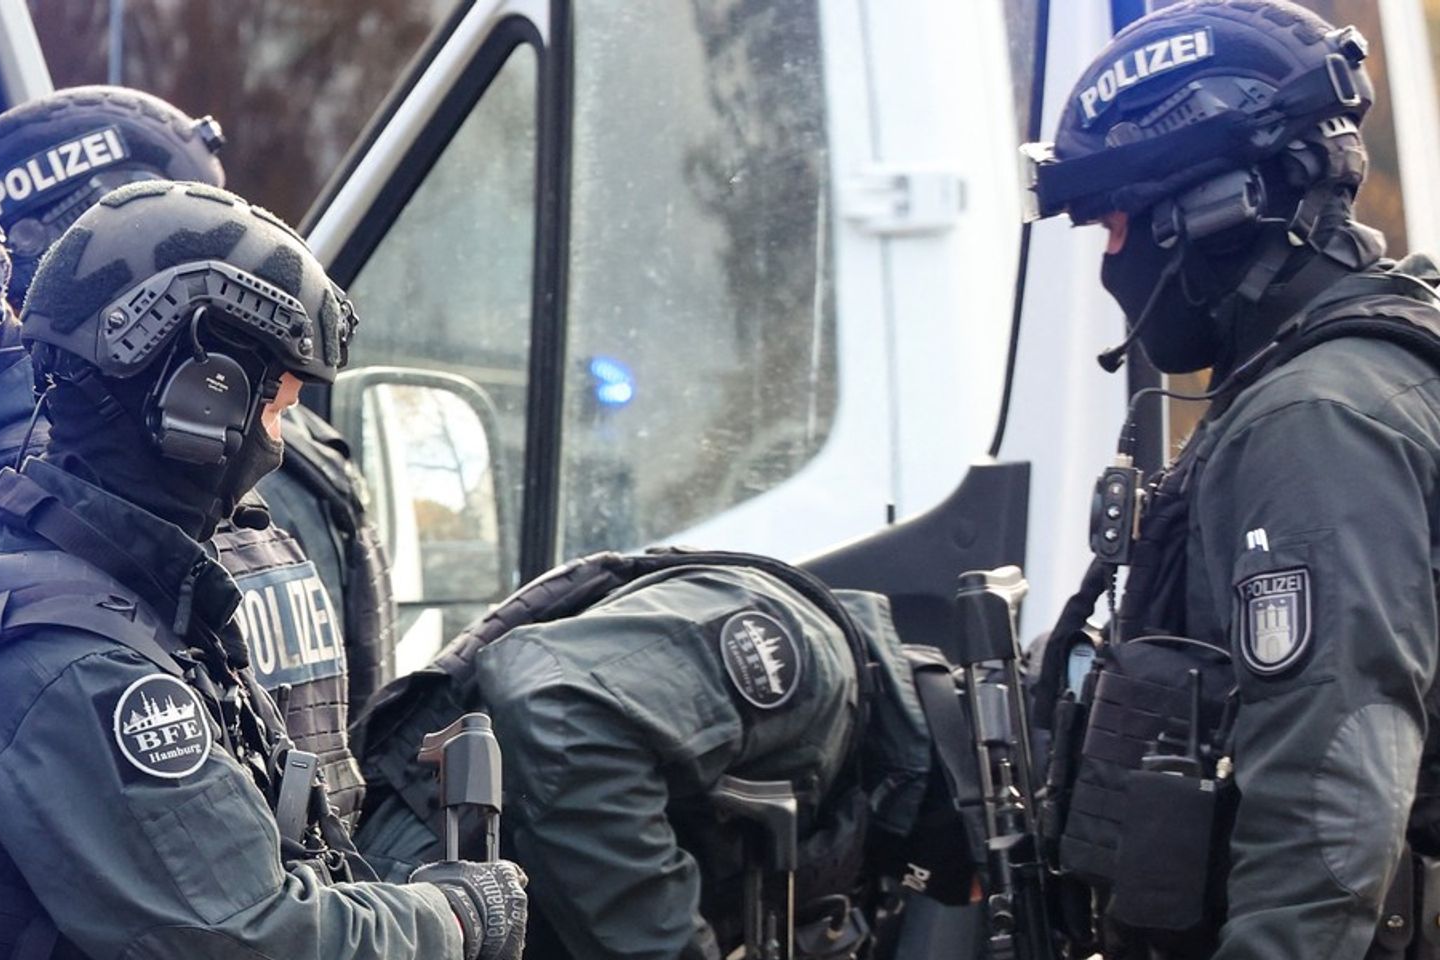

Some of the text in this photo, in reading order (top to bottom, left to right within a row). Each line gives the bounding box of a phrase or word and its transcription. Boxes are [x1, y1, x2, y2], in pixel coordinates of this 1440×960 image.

[1080, 31, 1208, 119] POLIZEI
[1247, 575, 1303, 597] POLIZEI
[234, 576, 342, 676] OLIZEI
[135, 719, 203, 753] BFE
[149, 743, 203, 764] Hamburg
